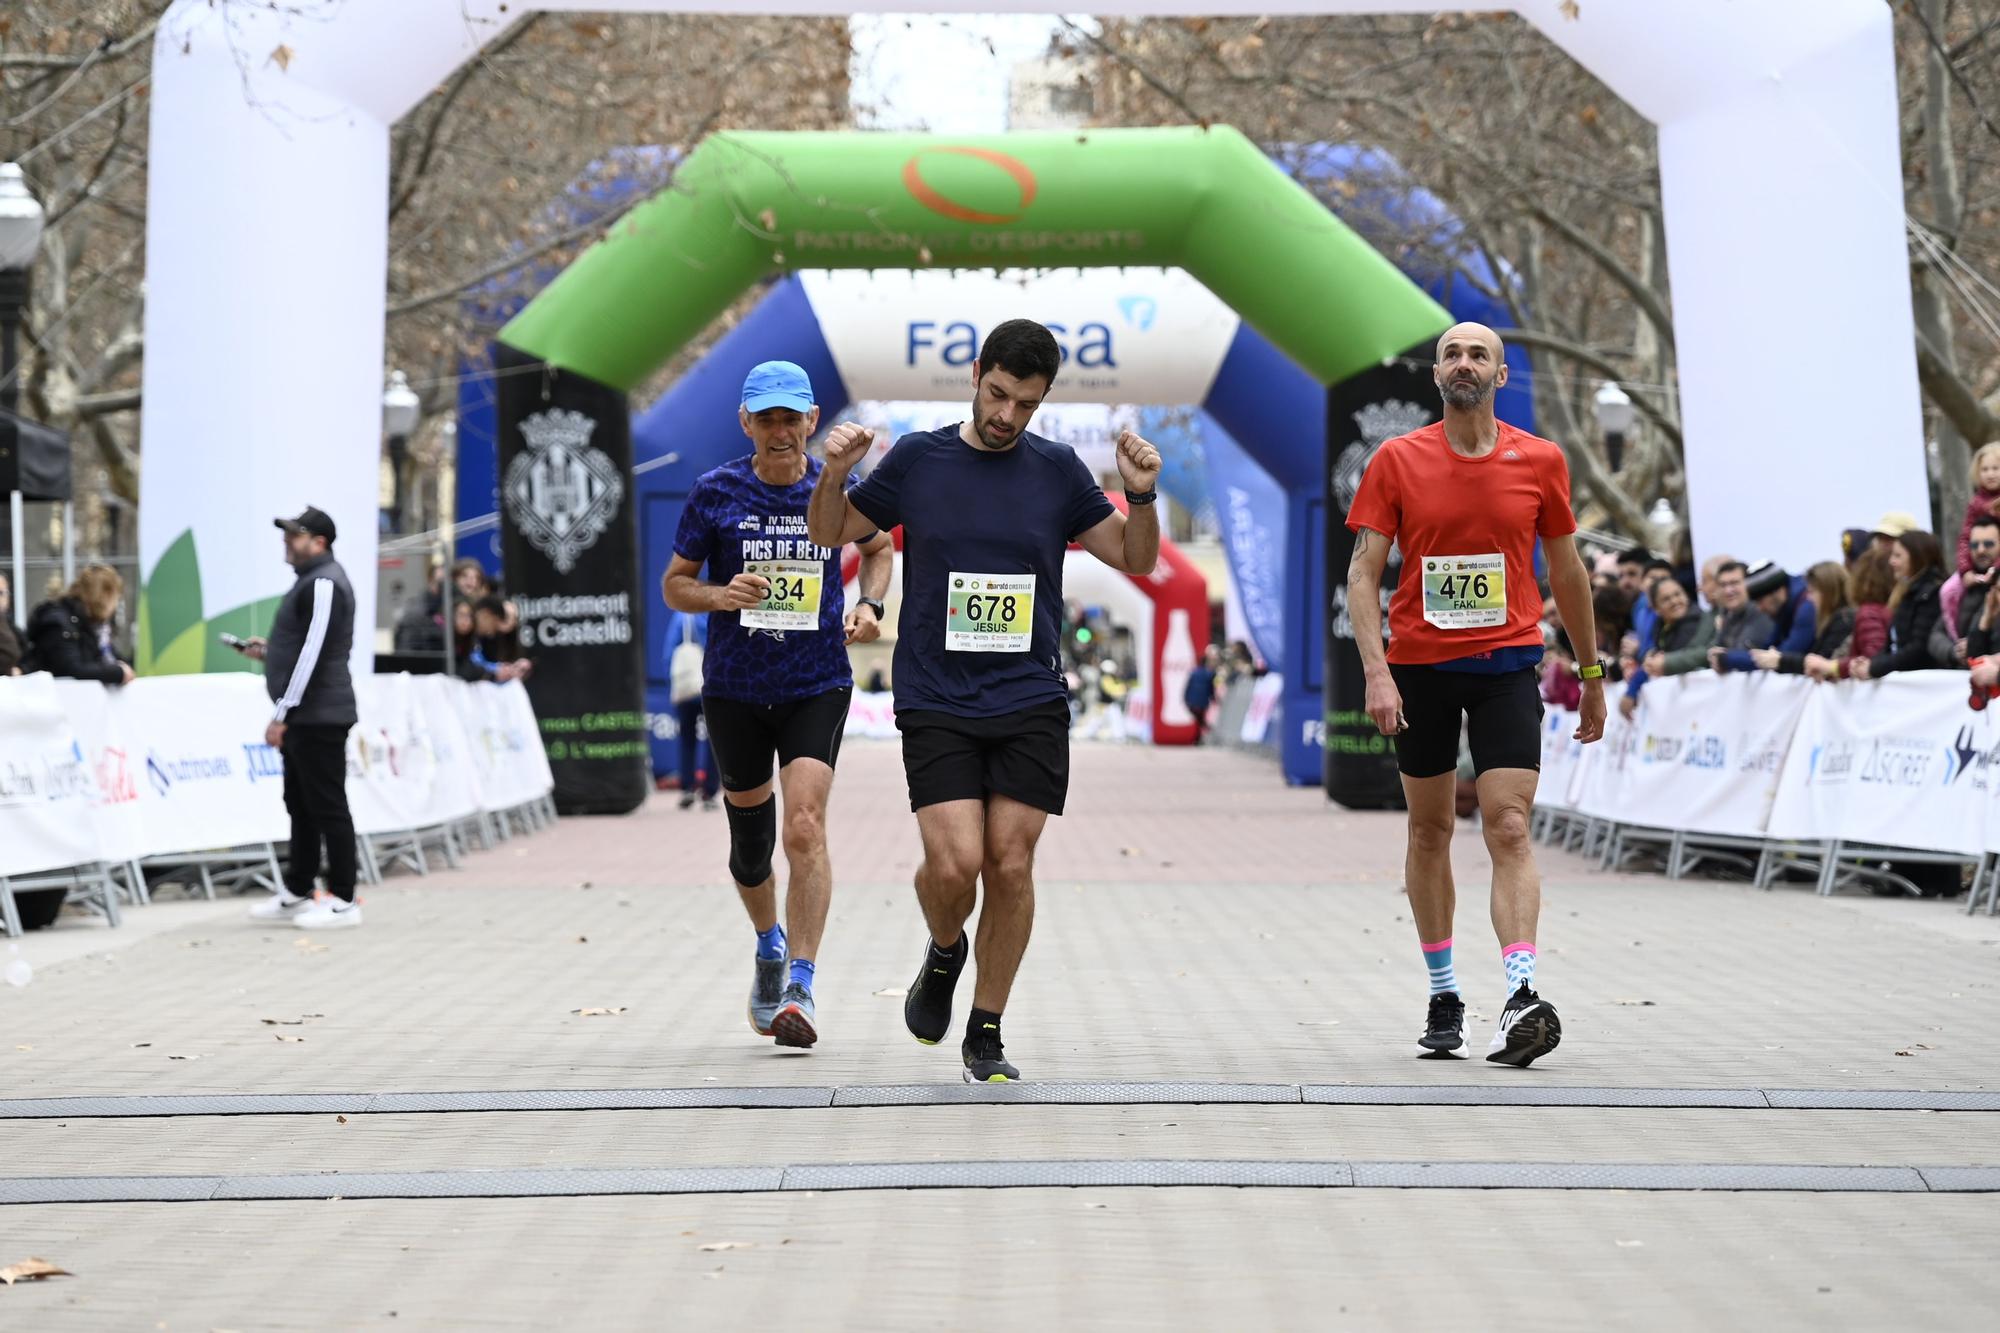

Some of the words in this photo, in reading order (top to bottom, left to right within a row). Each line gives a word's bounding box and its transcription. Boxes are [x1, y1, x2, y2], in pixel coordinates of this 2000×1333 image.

[768, 516, 777, 526] IV
[779, 516, 806, 526] TRAIL
[765, 525, 775, 535] III
[743, 540, 773, 560] PICS
[776, 540, 793, 560] DE
[1440, 573, 1489, 600] 476
[766, 601, 795, 611] AGUS
[966, 594, 1016, 622] 678
[1453, 600, 1476, 610] FAKI
[973, 622, 1008, 633] JESUS
